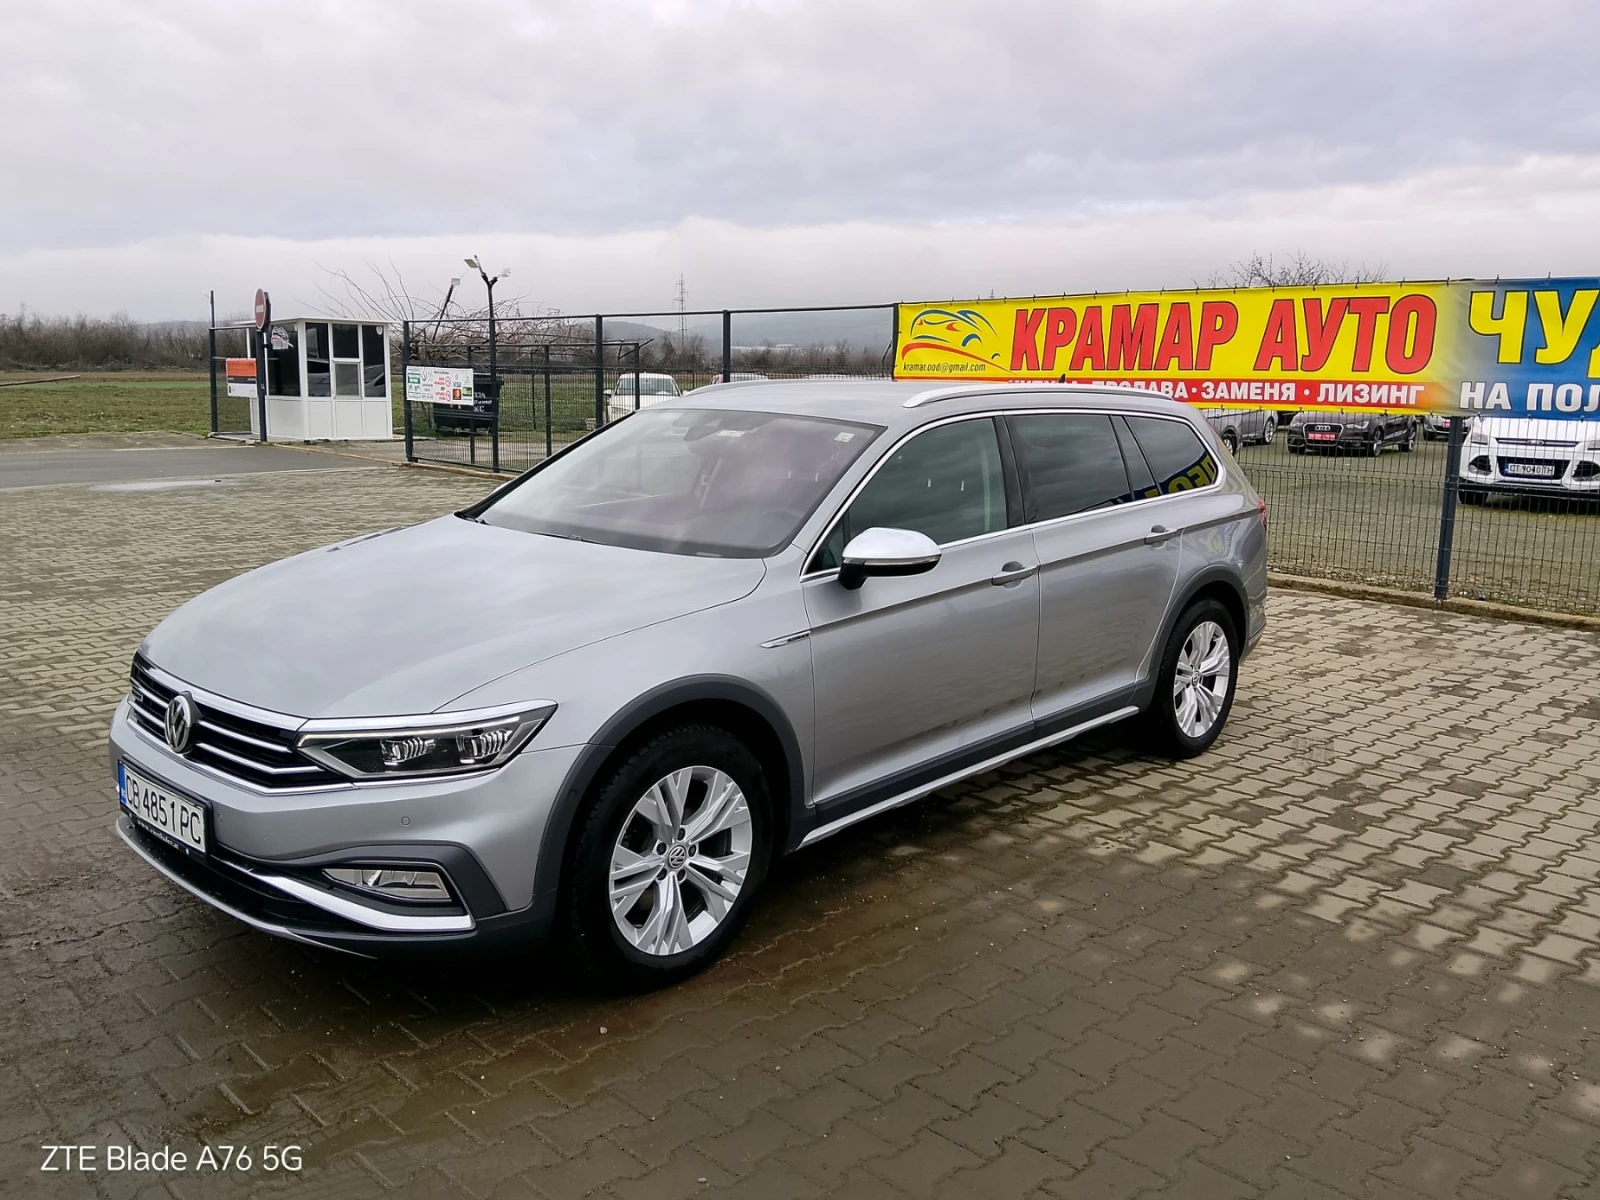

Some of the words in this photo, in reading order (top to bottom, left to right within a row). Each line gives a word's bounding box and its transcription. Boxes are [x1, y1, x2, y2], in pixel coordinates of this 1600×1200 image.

[1010, 301, 1239, 371] КРАМАР
[1253, 294, 1437, 374] АУТО
[1468, 288, 1600, 379] ЧУ
[903, 362, 986, 374] kramar.ood@gmail.com
[1201, 381, 1295, 401] ЗАМЕНЯ
[1316, 382, 1425, 405] ЛИЗИНГ
[1459, 381, 1512, 410] НА
[143, 787, 176, 833] 4851
